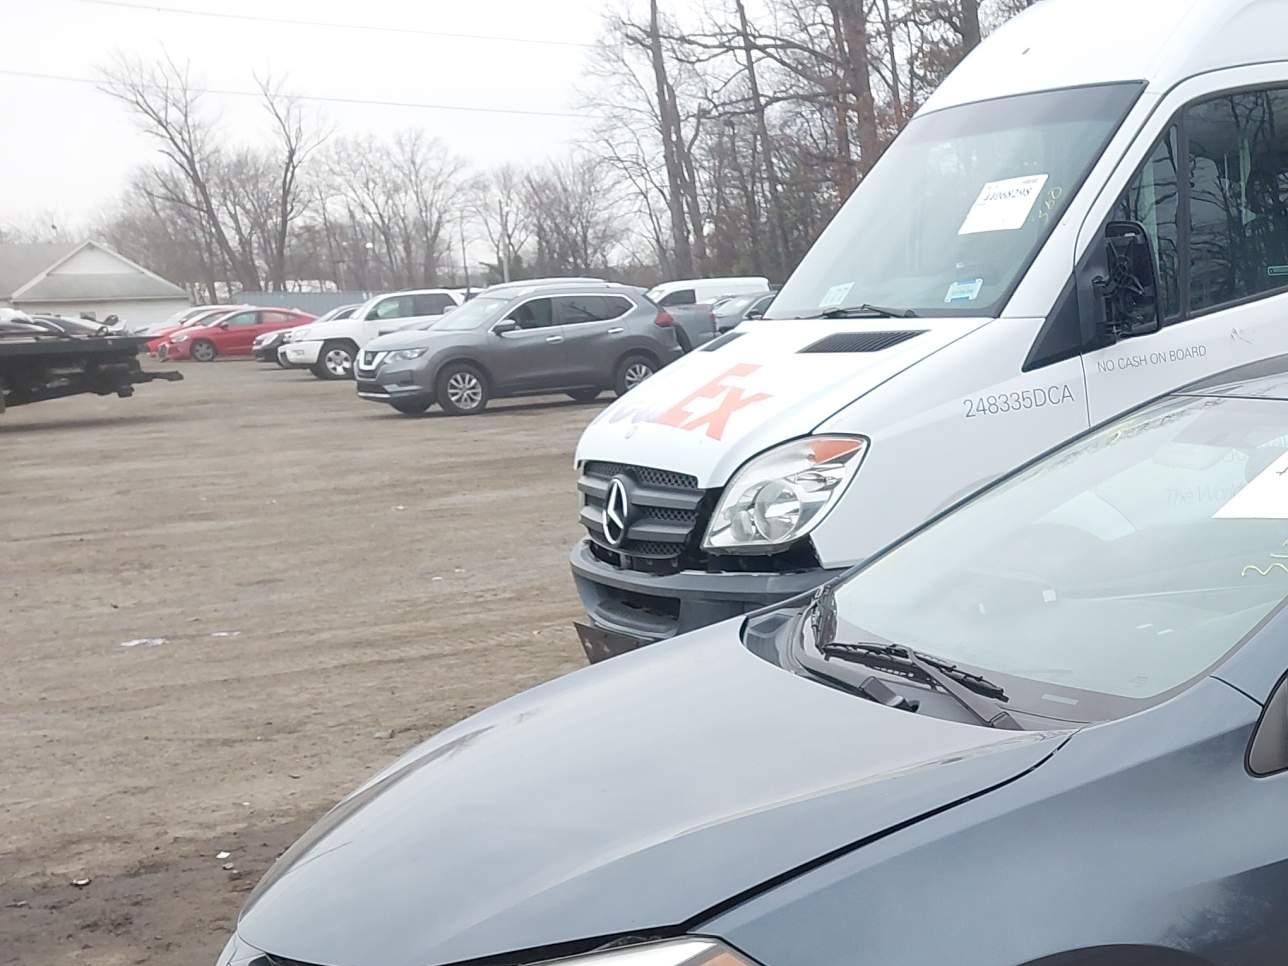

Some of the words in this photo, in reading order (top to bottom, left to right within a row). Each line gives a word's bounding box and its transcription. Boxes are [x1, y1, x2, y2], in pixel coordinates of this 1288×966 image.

[1097, 360, 1115, 374] NO
[1117, 355, 1148, 371] CASH
[1151, 352, 1167, 366] ON
[1169, 344, 1207, 363] BOARD
[963, 384, 1074, 418] 248335DCA
